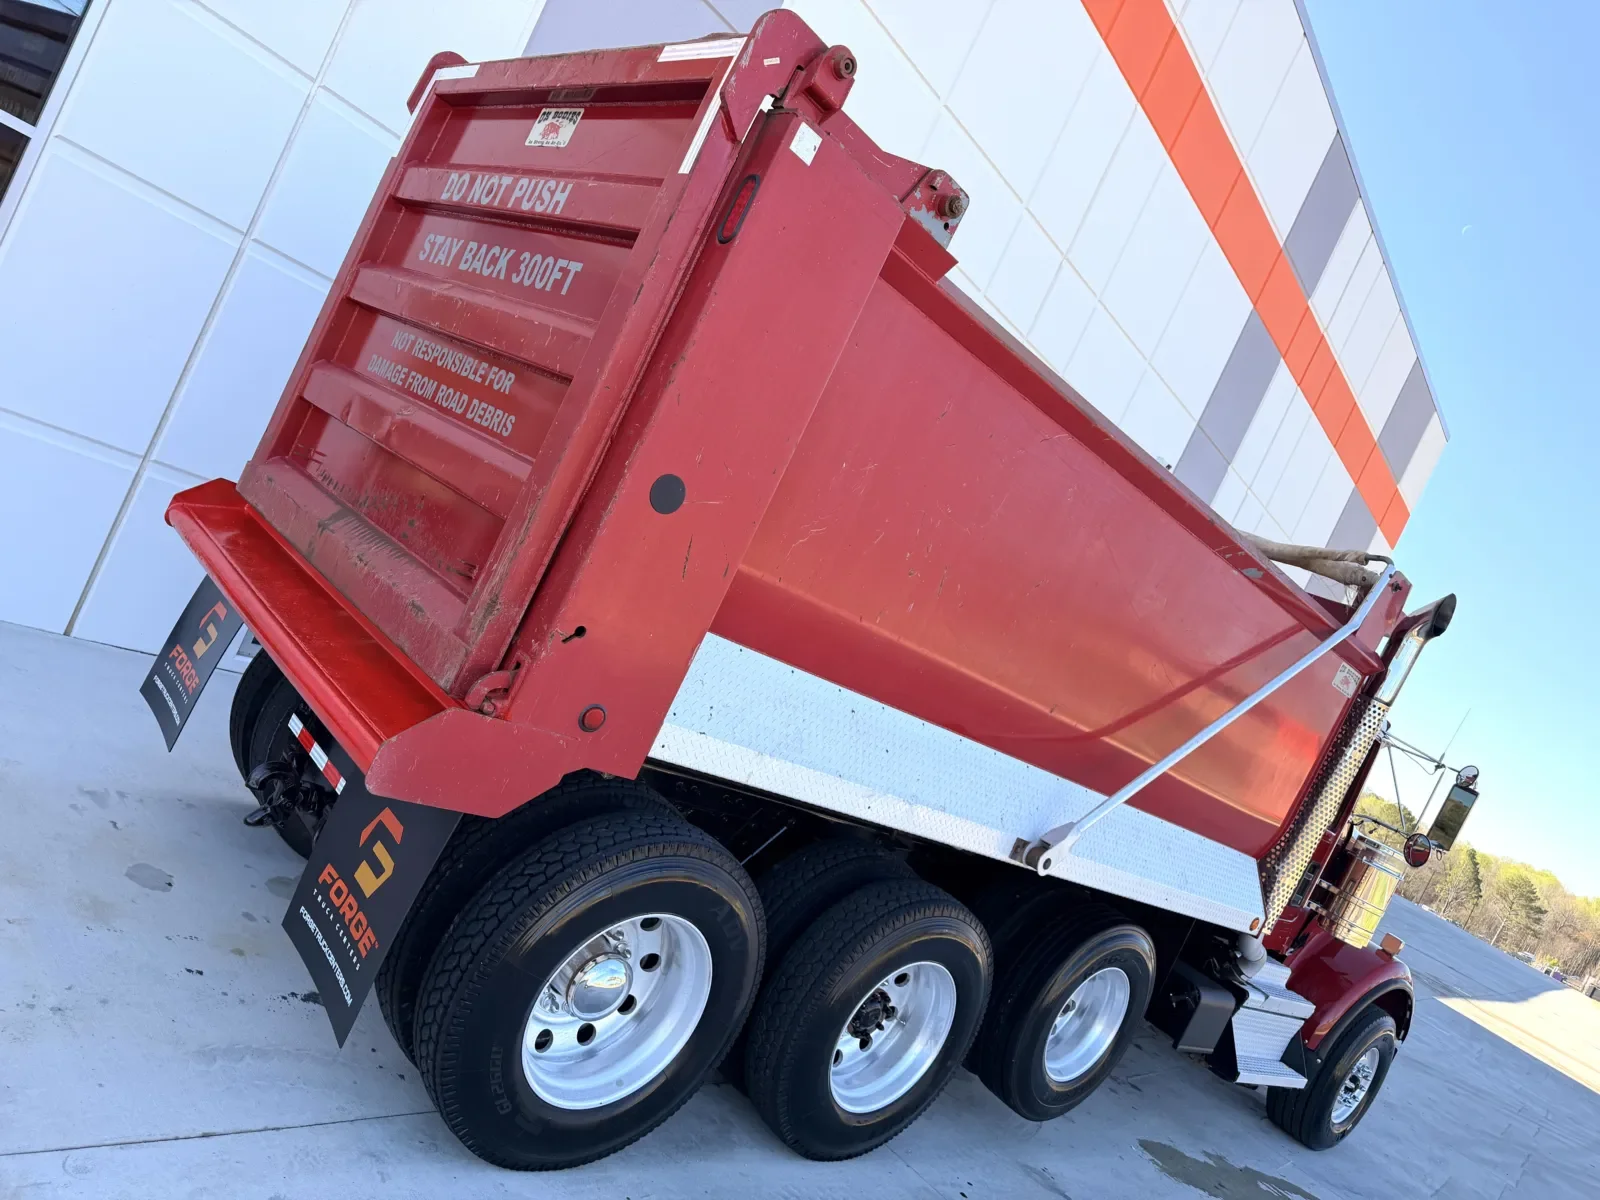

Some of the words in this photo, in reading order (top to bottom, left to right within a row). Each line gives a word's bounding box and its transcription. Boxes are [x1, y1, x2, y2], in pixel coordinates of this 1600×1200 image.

[537, 111, 552, 124] OX
[552, 111, 581, 125] BODIES
[440, 172, 471, 202] DO
[466, 174, 514, 207] NOT
[507, 178, 574, 215] PUSH
[418, 233, 464, 267] STAY
[458, 241, 516, 280] BACK
[511, 251, 584, 296] 300FT
[391, 330, 416, 352] NOT
[411, 338, 489, 384] RESPONSIBLE
[484, 366, 516, 395] FOR
[367, 354, 408, 386] DAMAGE
[404, 371, 438, 403] FROM
[434, 384, 469, 415] ROAD
[466, 399, 516, 437] DEBRIS
[168, 643, 200, 696] FORGE
[313, 888, 334, 922] TRUCK
[335, 923, 361, 971] CENTERS
[317, 862, 377, 959] FORGE
[299, 905, 353, 1008] FORGETRUCKCENTERS.COM
